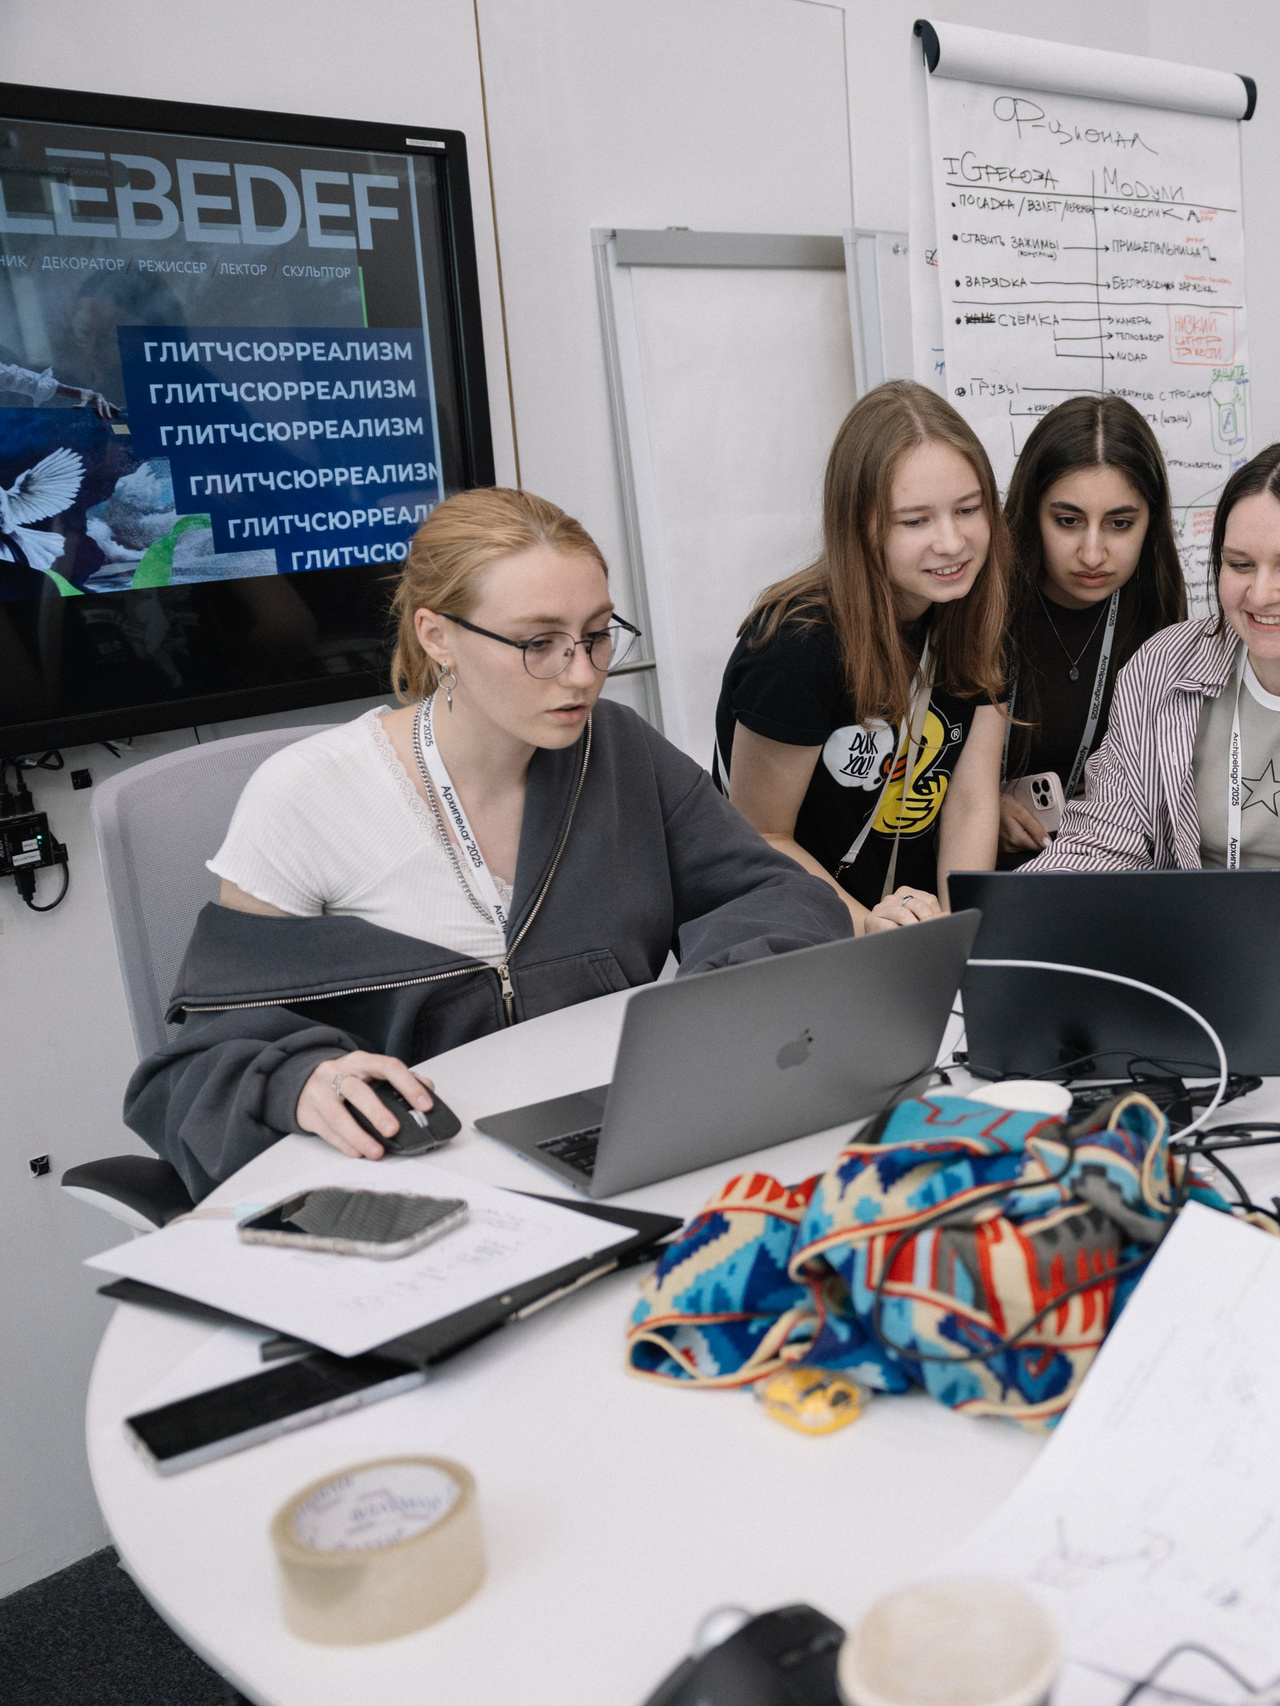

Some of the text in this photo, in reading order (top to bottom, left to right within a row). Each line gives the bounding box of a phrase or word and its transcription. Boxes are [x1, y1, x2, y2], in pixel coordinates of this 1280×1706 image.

[41, 256, 126, 272] ДЕКОРАТОР
[138, 259, 208, 275] РЕЖИССЕР
[219, 263, 267, 276] ЛЕКТОР
[282, 264, 351, 279] СКУЛЬПТОР
[965, 275, 1028, 289] ЗАРЯДКА
[143, 341, 413, 364] ГЛИТЧСЮРРЕАЛИЗМ
[149, 379, 417, 405] ГЛИТЧСЮРРЕАЛИЗМ
[160, 416, 425, 447] ГЛИТЧСЮРРЕАЛИЗМ
[291, 540, 412, 571] ГЛИТЧСЮ
[440, 785, 484, 869] Архипелаг'2025
